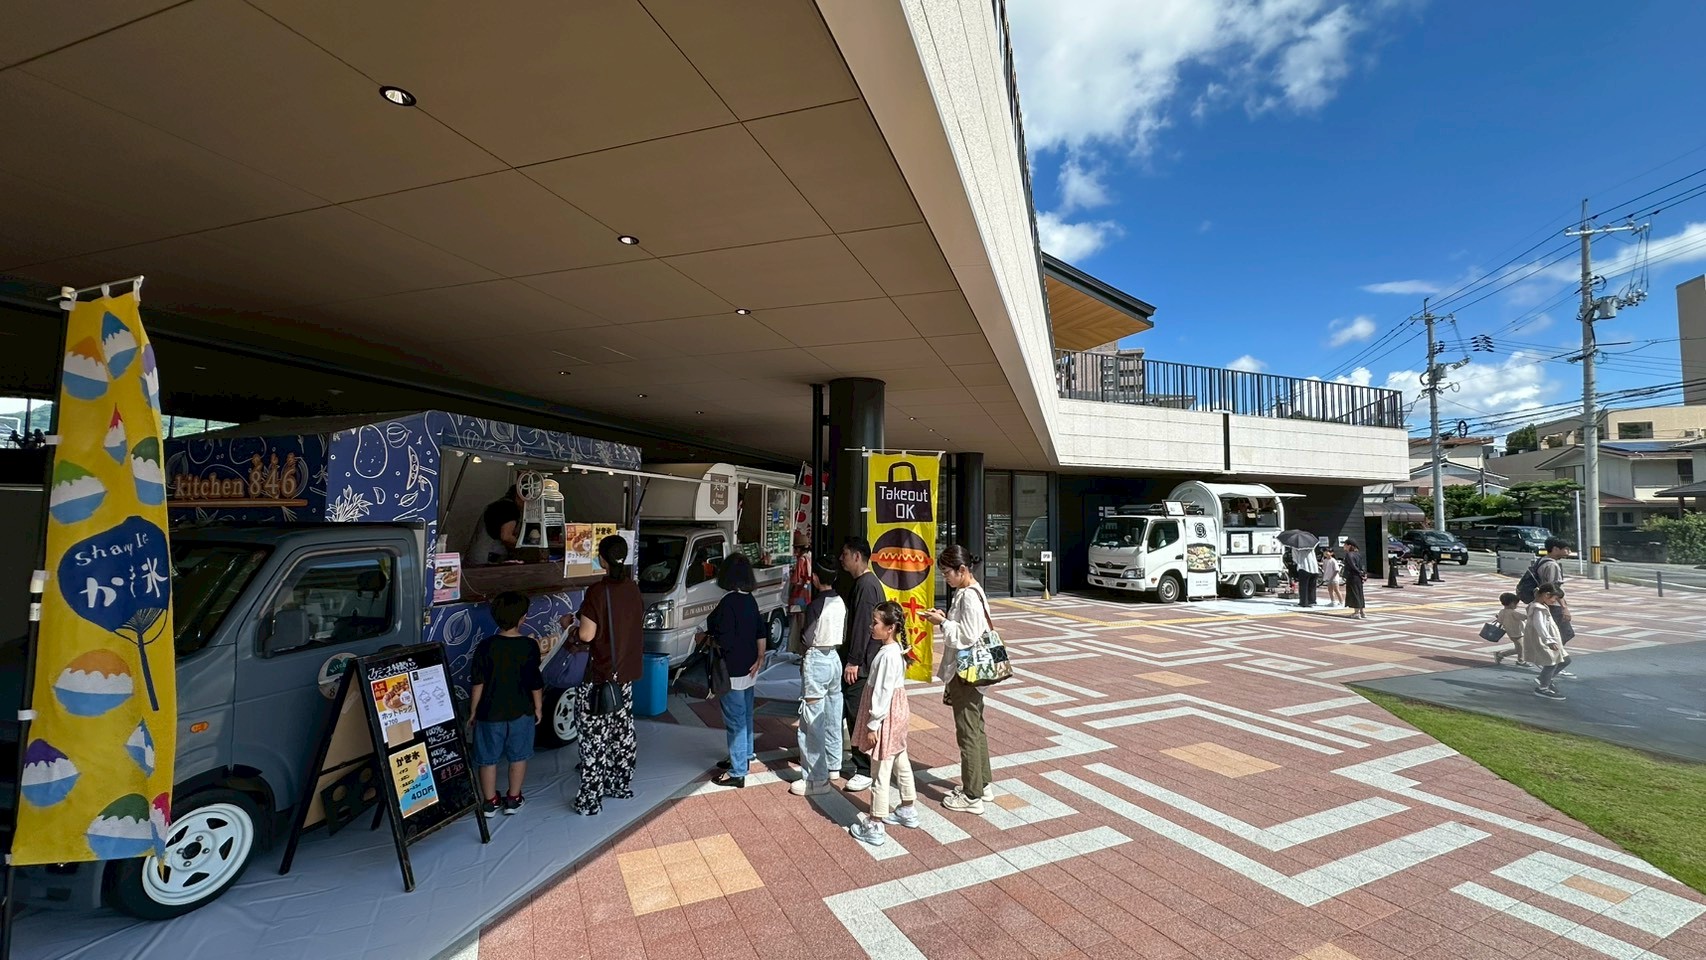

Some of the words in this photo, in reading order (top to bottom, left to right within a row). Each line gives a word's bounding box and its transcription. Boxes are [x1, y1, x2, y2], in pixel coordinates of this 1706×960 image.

[174, 474, 244, 497] kitchen
[249, 468, 297, 496] 846
[878, 486, 929, 503] Takeout
[895, 503, 916, 520] OK
[396, 750, 420, 767] かき氷
[411, 784, 434, 801] 400円
